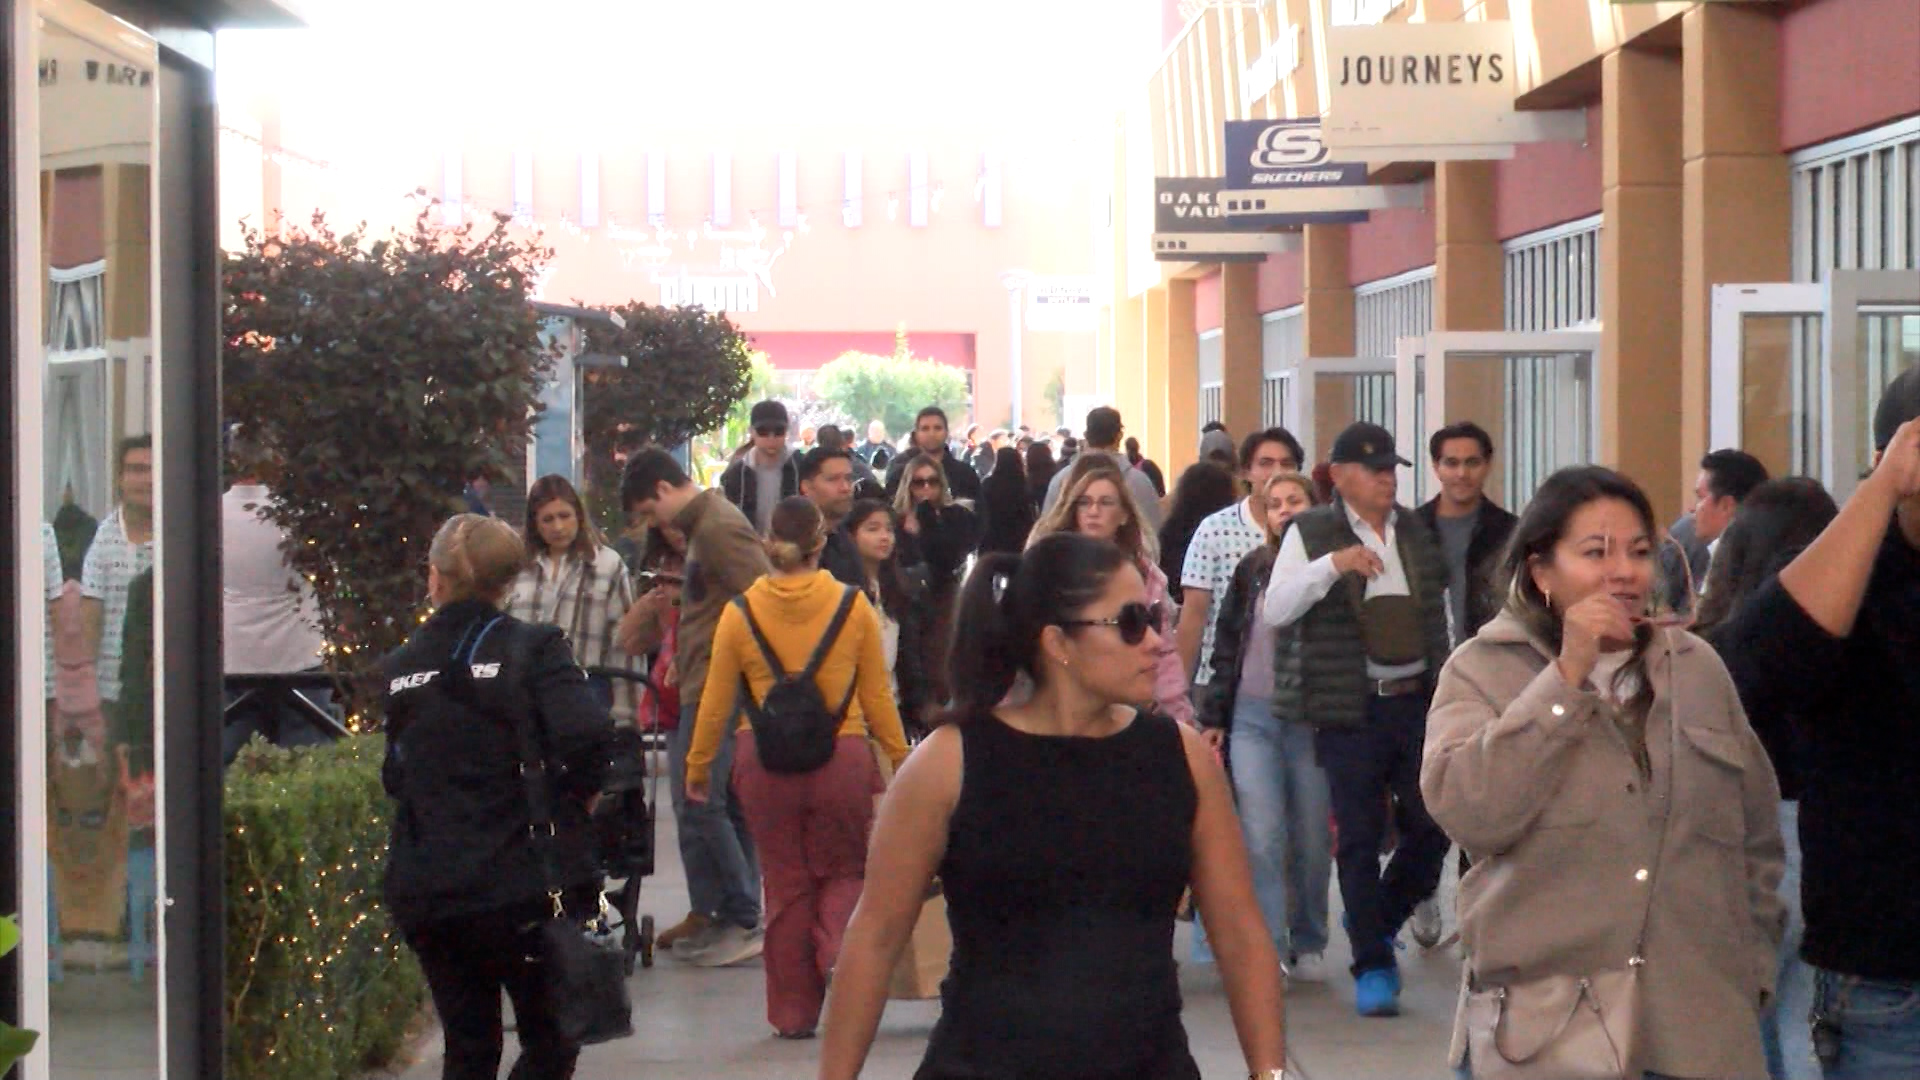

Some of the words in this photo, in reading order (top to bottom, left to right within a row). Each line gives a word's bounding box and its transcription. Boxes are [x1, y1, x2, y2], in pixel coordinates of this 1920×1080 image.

[1341, 54, 1504, 86] JOURNEYS
[1251, 171, 1343, 184] SKECHERS
[1160, 192, 1220, 204] OAK
[1173, 206, 1220, 218] VAU
